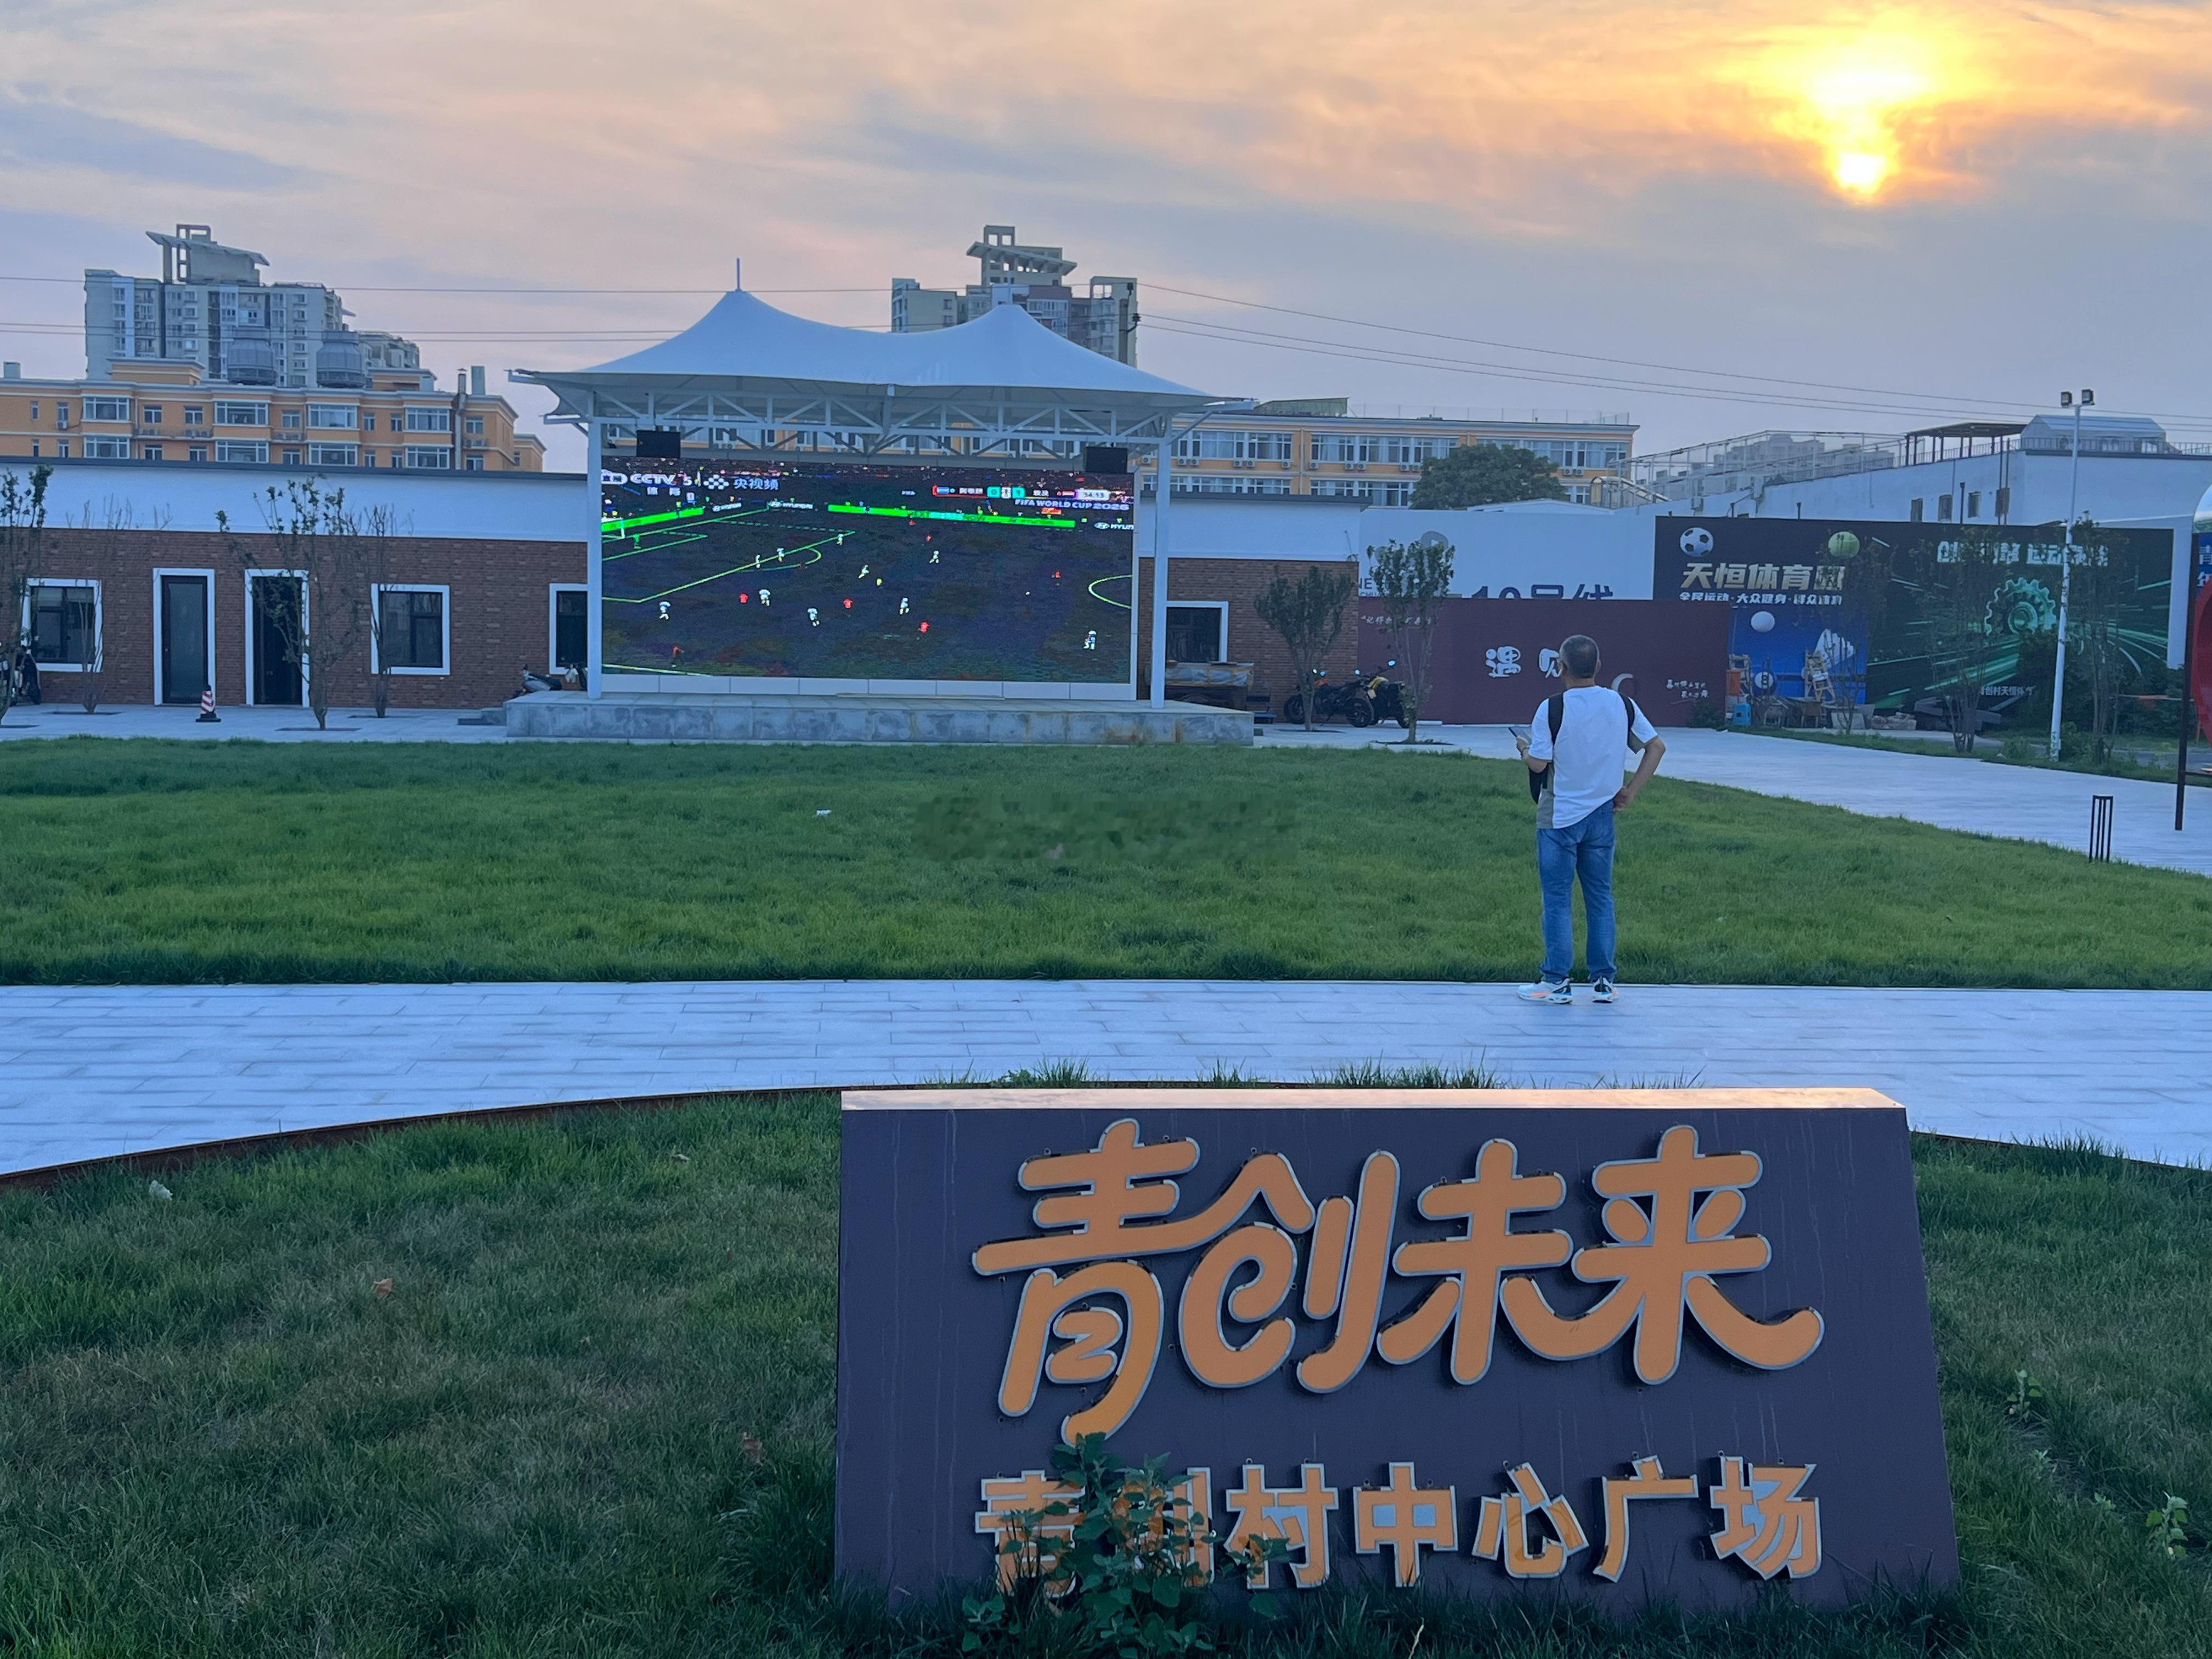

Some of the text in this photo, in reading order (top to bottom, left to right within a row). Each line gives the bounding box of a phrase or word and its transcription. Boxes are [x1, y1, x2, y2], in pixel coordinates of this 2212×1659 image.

[630, 473, 676, 485] CCTV
[734, 478, 779, 490] 央视频
[1036, 500, 1070, 508] WORLD
[1072, 501, 1093, 509] CUP
[972, 1118, 1825, 1447] 青创未来
